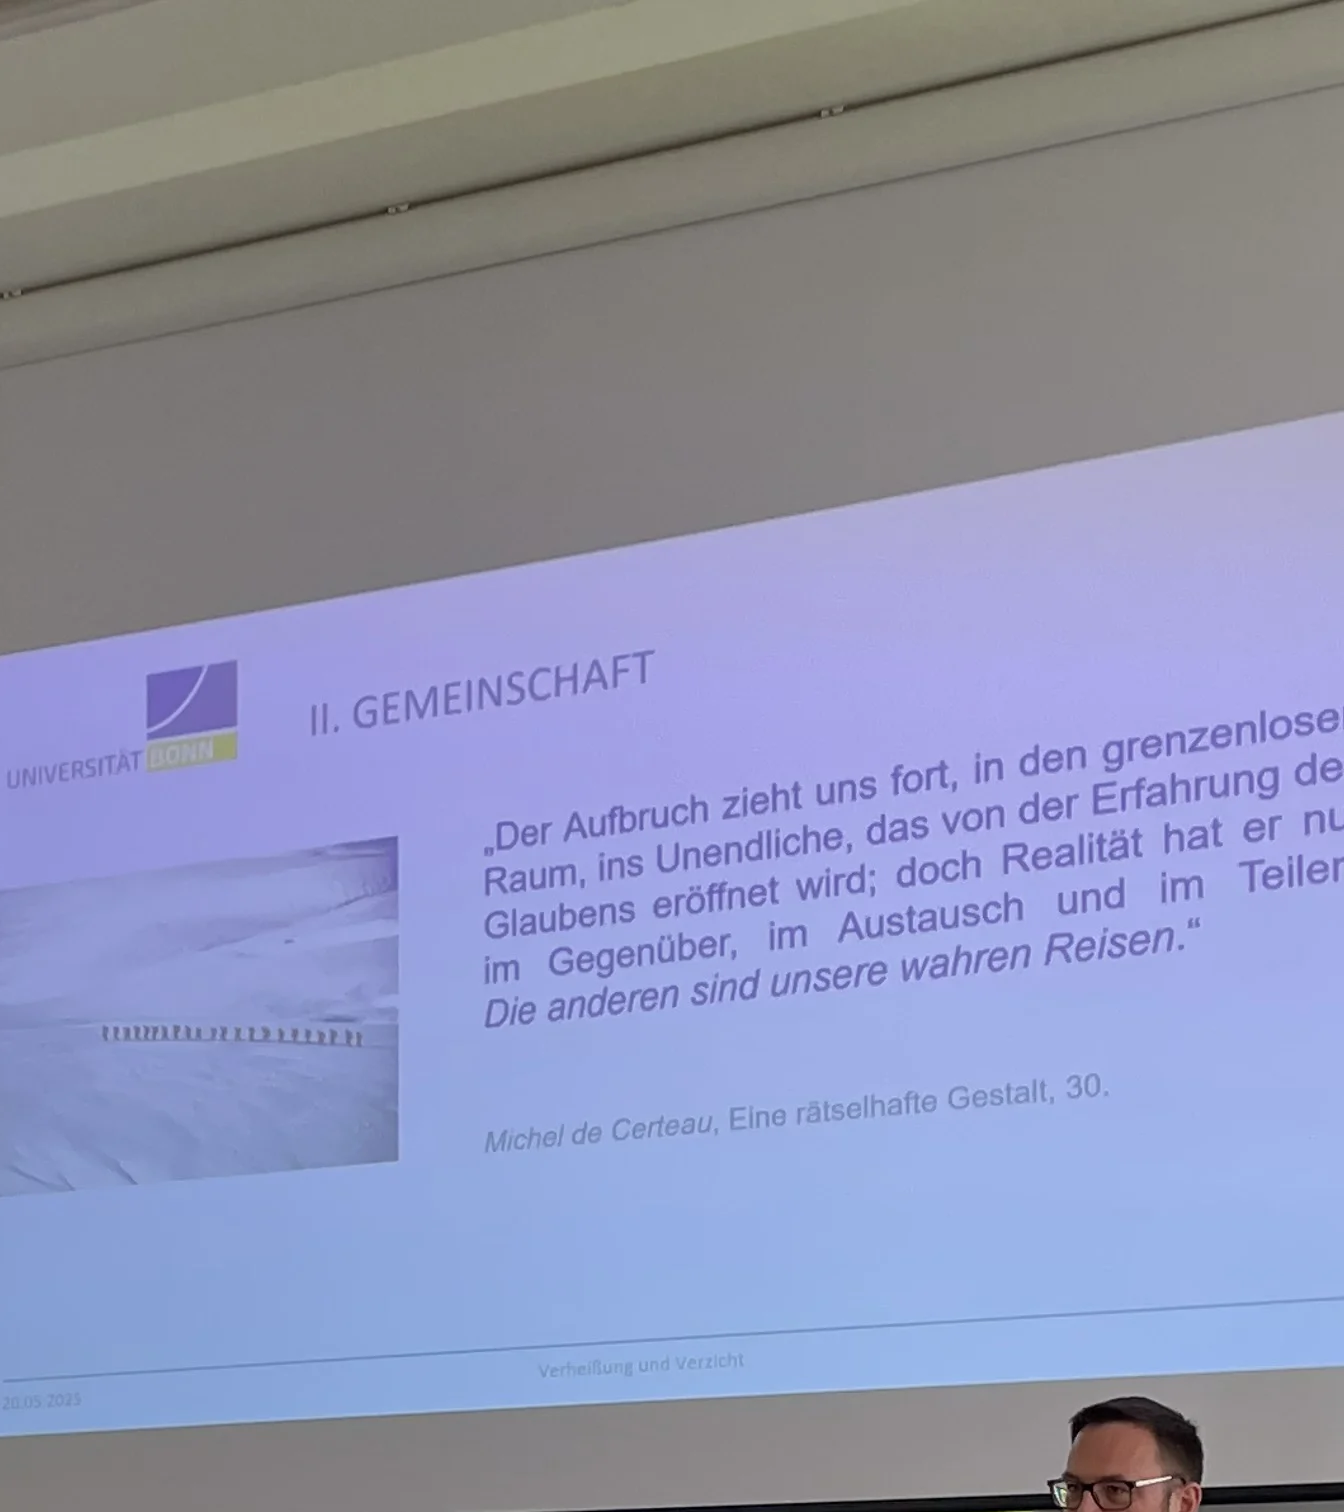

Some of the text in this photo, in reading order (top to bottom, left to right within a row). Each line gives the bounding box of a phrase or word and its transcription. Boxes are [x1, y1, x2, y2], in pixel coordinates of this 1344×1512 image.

[310, 649, 656, 736] II. GEMEINSCHAFT
[6, 740, 214, 789] UNIVERSITÄT BONN
[484, 820, 552, 856] „Der
[563, 794, 709, 843] Aufbruch
[722, 781, 803, 821] zieht
[816, 774, 878, 807] uns
[891, 760, 958, 795] fort,
[974, 752, 1004, 784] in
[1019, 744, 1087, 777] den
[484, 864, 585, 896] Raum,
[599, 851, 644, 881] ins
[657, 824, 853, 873] Unendliche,
[866, 813, 929, 846] das
[942, 804, 1005, 835] von
[1019, 793, 1079, 824] der
[1093, 766, 1280, 816] Erfahrung
[484, 898, 635, 939] Glaubens
[653, 877, 779, 919] eröffnet
[797, 865, 877, 900] wird;
[896, 851, 981, 888] doch
[1003, 829, 1143, 874] Realität
[1164, 818, 1223, 854] hat
[1243, 814, 1282, 843] er
[484, 956, 520, 984] im
[549, 931, 738, 979] Gegenüber,
[769, 921, 808, 951] im
[838, 893, 1024, 943] Austausch
[1058, 878, 1126, 915] und
[1160, 873, 1204, 903] im
[484, 996, 537, 1028] Die
[547, 983, 679, 1023] anderen
[690, 969, 760, 1007] sind
[771, 961, 888, 998] unsere
[901, 942, 1032, 983] wahren
[484, 1072, 1110, 1153] Michel de Certeau, Eine rätselhafte Gestalt, 30.
[538, 1350, 746, 1381] Verheißung und Verzicht
